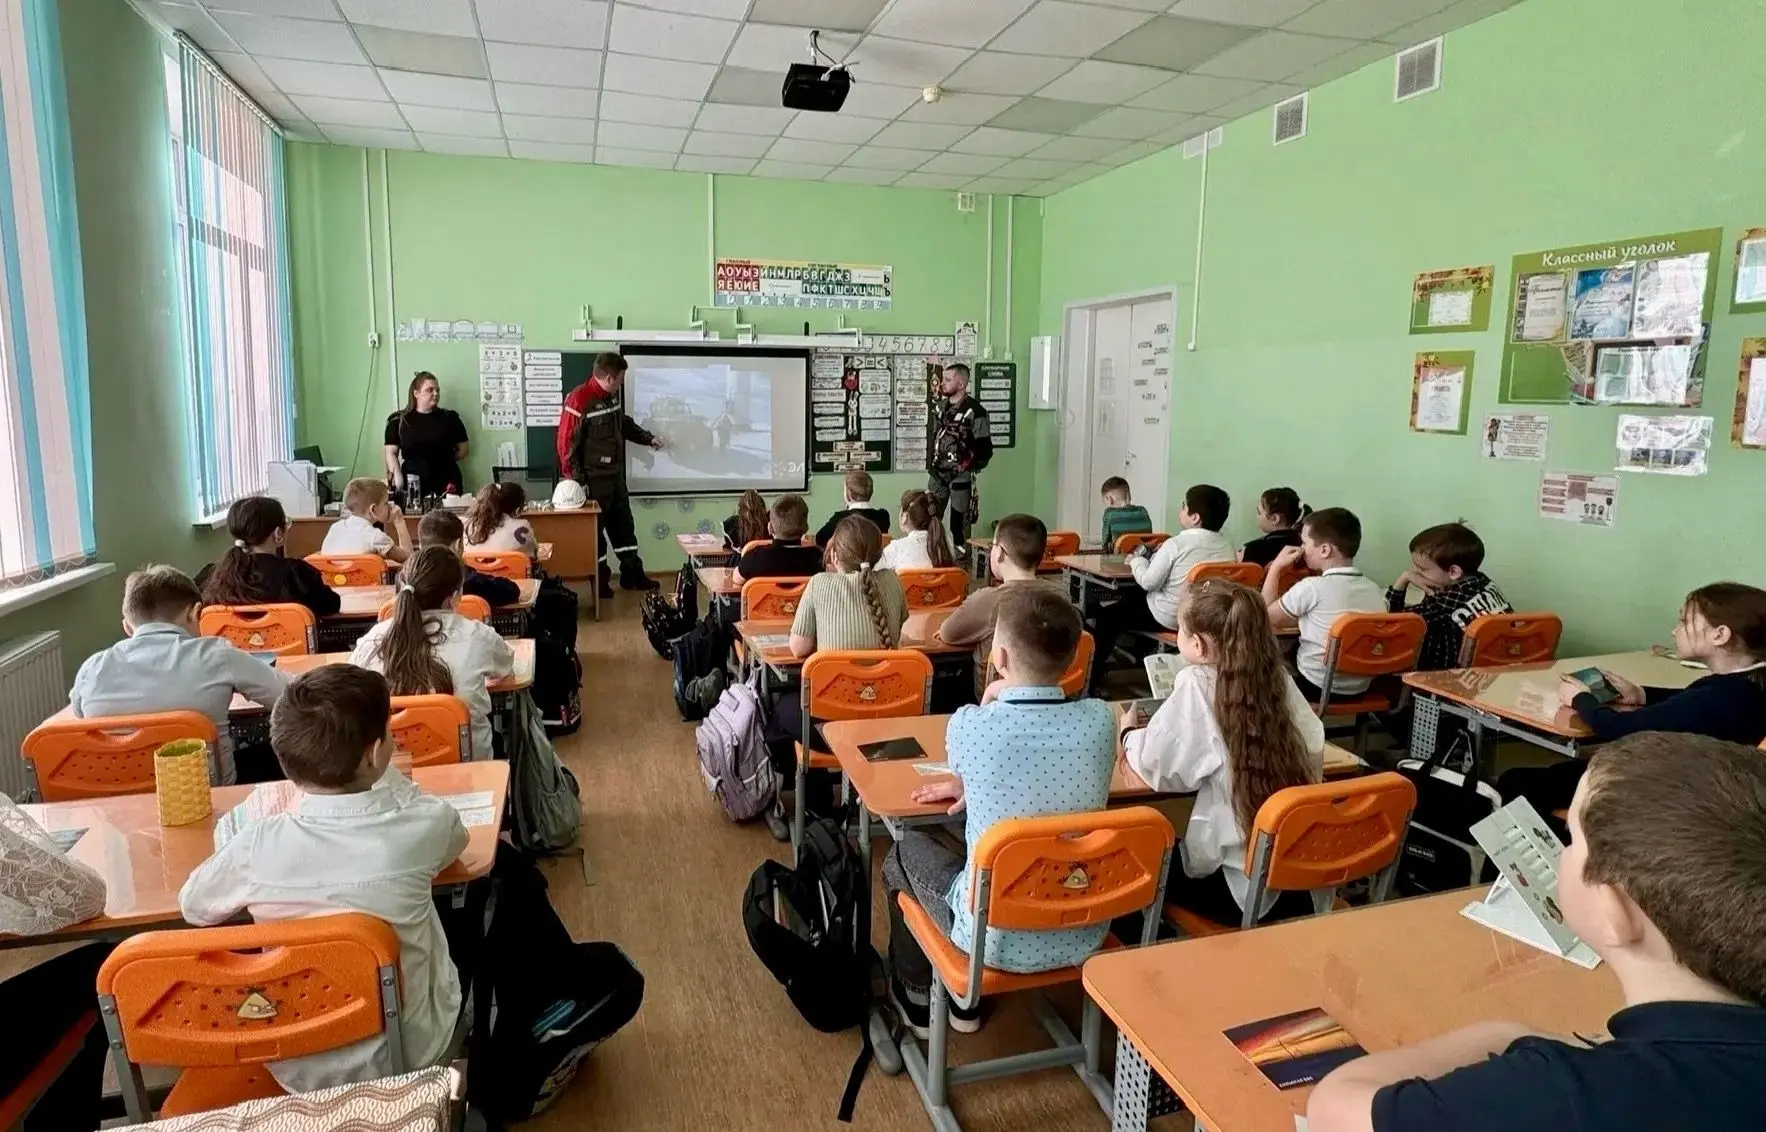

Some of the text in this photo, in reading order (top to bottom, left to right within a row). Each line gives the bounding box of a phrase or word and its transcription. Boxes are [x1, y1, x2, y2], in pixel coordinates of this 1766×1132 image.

[1541, 239, 1678, 267] Классный уголок
[878, 336, 887, 352] 4
[892, 337, 901, 352] 5
[904, 337, 914, 352] 6
[918, 337, 927, 352] 7
[930, 337, 940, 353] 8
[943, 337, 953, 353] 9
